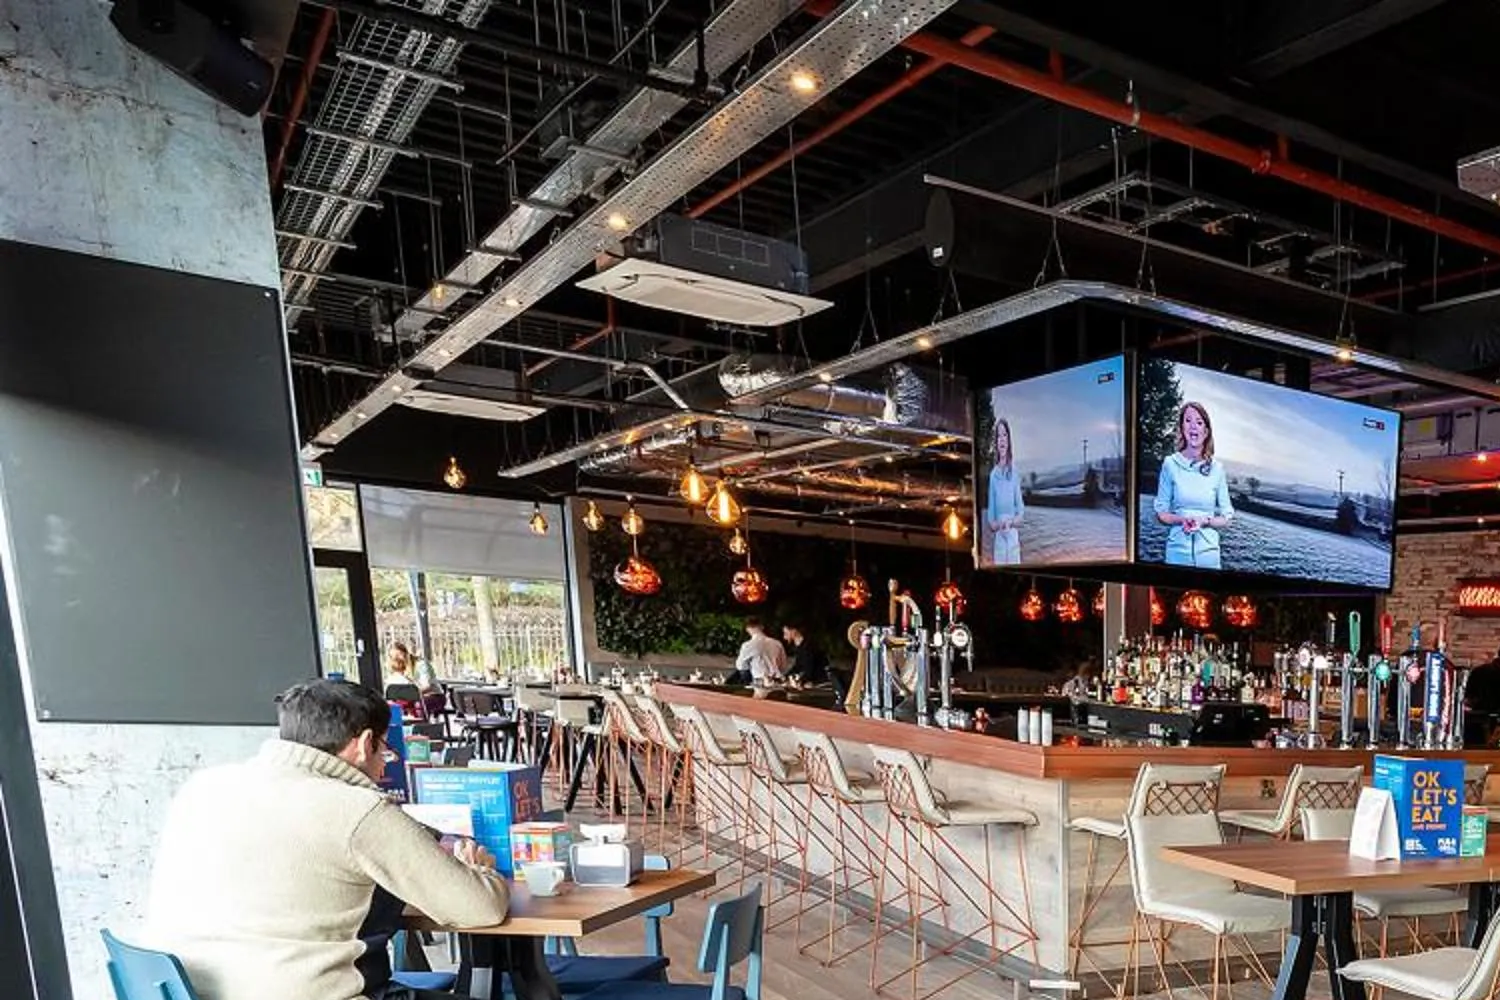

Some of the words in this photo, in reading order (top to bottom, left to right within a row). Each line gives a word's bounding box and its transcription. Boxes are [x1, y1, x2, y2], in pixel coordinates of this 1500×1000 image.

[1413, 771, 1441, 788] OK
[1412, 789, 1457, 806] LET'S
[1411, 806, 1443, 823] EAT
